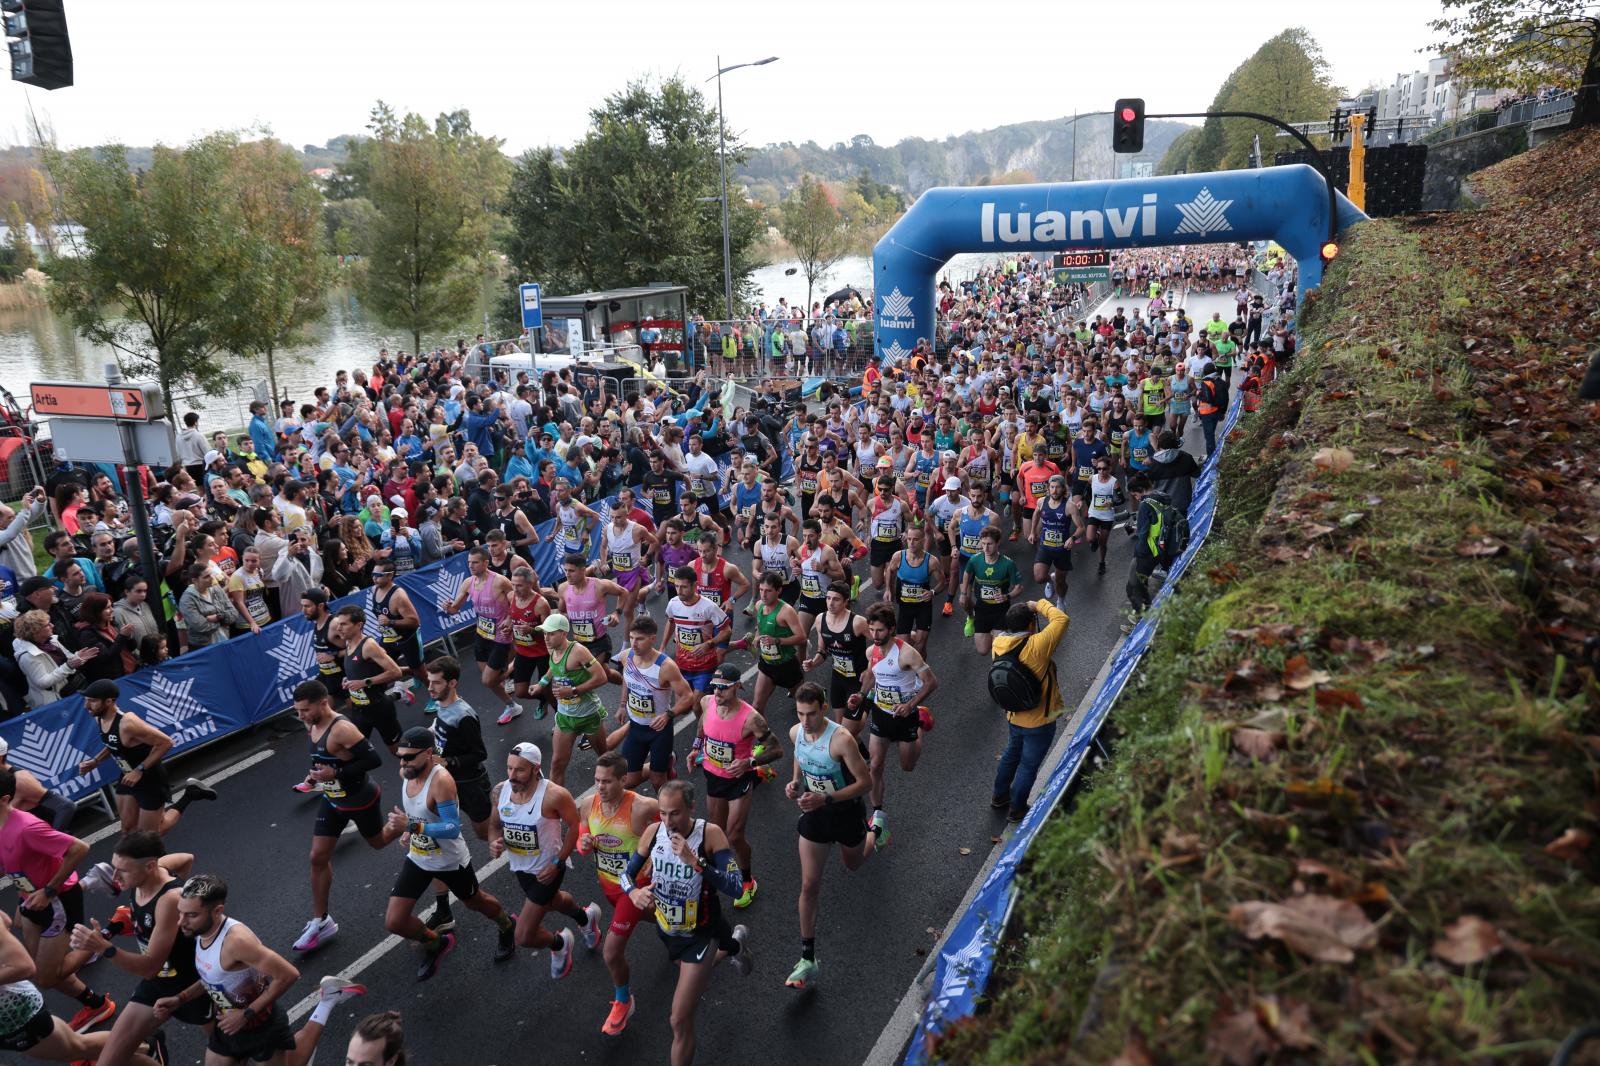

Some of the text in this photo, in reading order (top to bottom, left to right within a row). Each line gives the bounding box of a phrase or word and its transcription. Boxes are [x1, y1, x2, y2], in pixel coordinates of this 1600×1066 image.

[981, 192, 1158, 243] luanvi
[1063, 254, 1104, 266] 10:00:17
[880, 317, 915, 329] luanvi
[35, 393, 58, 406] Artia
[965, 538, 980, 546] 177
[1047, 532, 1060, 540] 124
[631, 697, 649, 708] 316
[171, 715, 217, 747] anvi
[711, 746, 725, 756] 55
[812, 781, 825, 790] 45
[506, 830, 531, 842] 366
[601, 858, 624, 870] 332
[656, 899, 676, 916] 291
